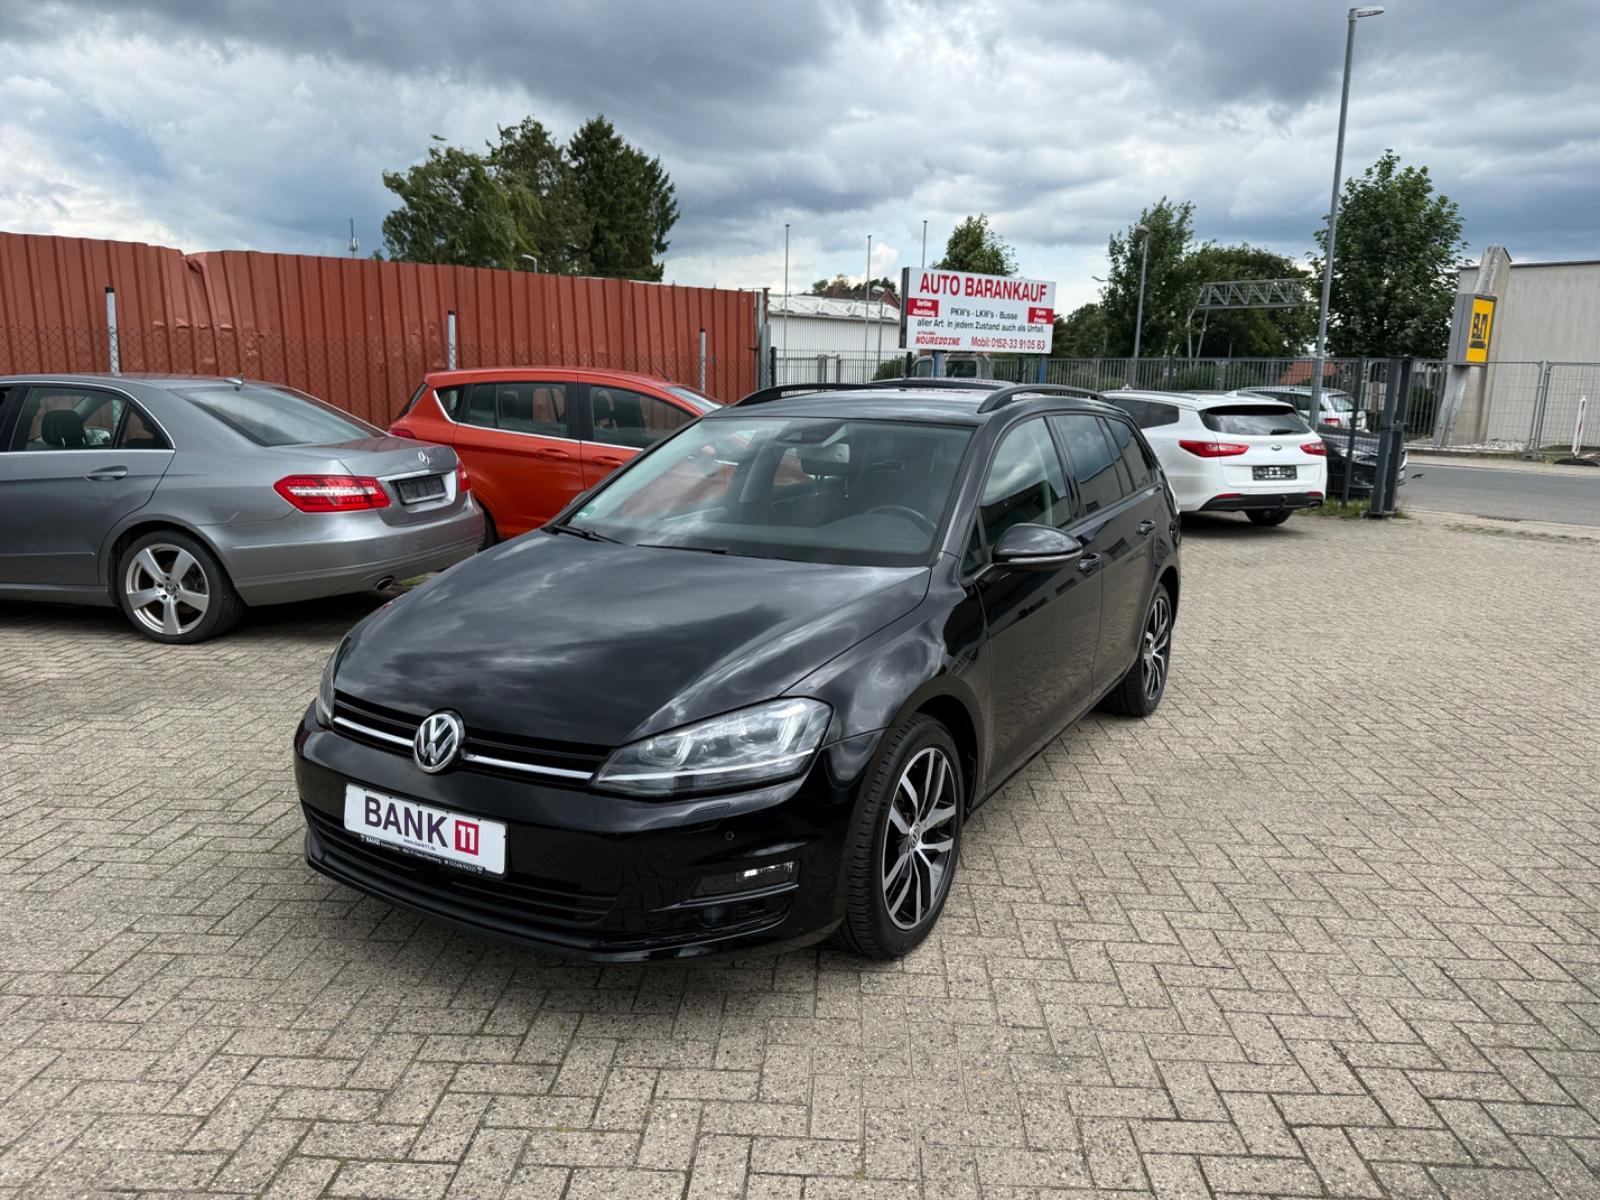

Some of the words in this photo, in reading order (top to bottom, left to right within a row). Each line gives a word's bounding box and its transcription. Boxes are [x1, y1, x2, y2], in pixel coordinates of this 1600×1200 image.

[920, 273, 960, 296] AUTO
[965, 277, 1047, 303] BARANKAUF
[950, 307, 970, 317] PKW's
[975, 309, 994, 318] LKW's
[1000, 310, 1018, 320] Busse
[917, 319, 932, 327] aller
[947, 320, 953, 328] in
[954, 320, 974, 331] jedem
[975, 321, 1000, 331] Zustand
[1001, 323, 1016, 332] auch
[1017, 324, 1026, 332] als
[971, 336, 990, 347] Mobil:
[365, 796, 448, 848] BANK
[457, 823, 477, 853] 11
